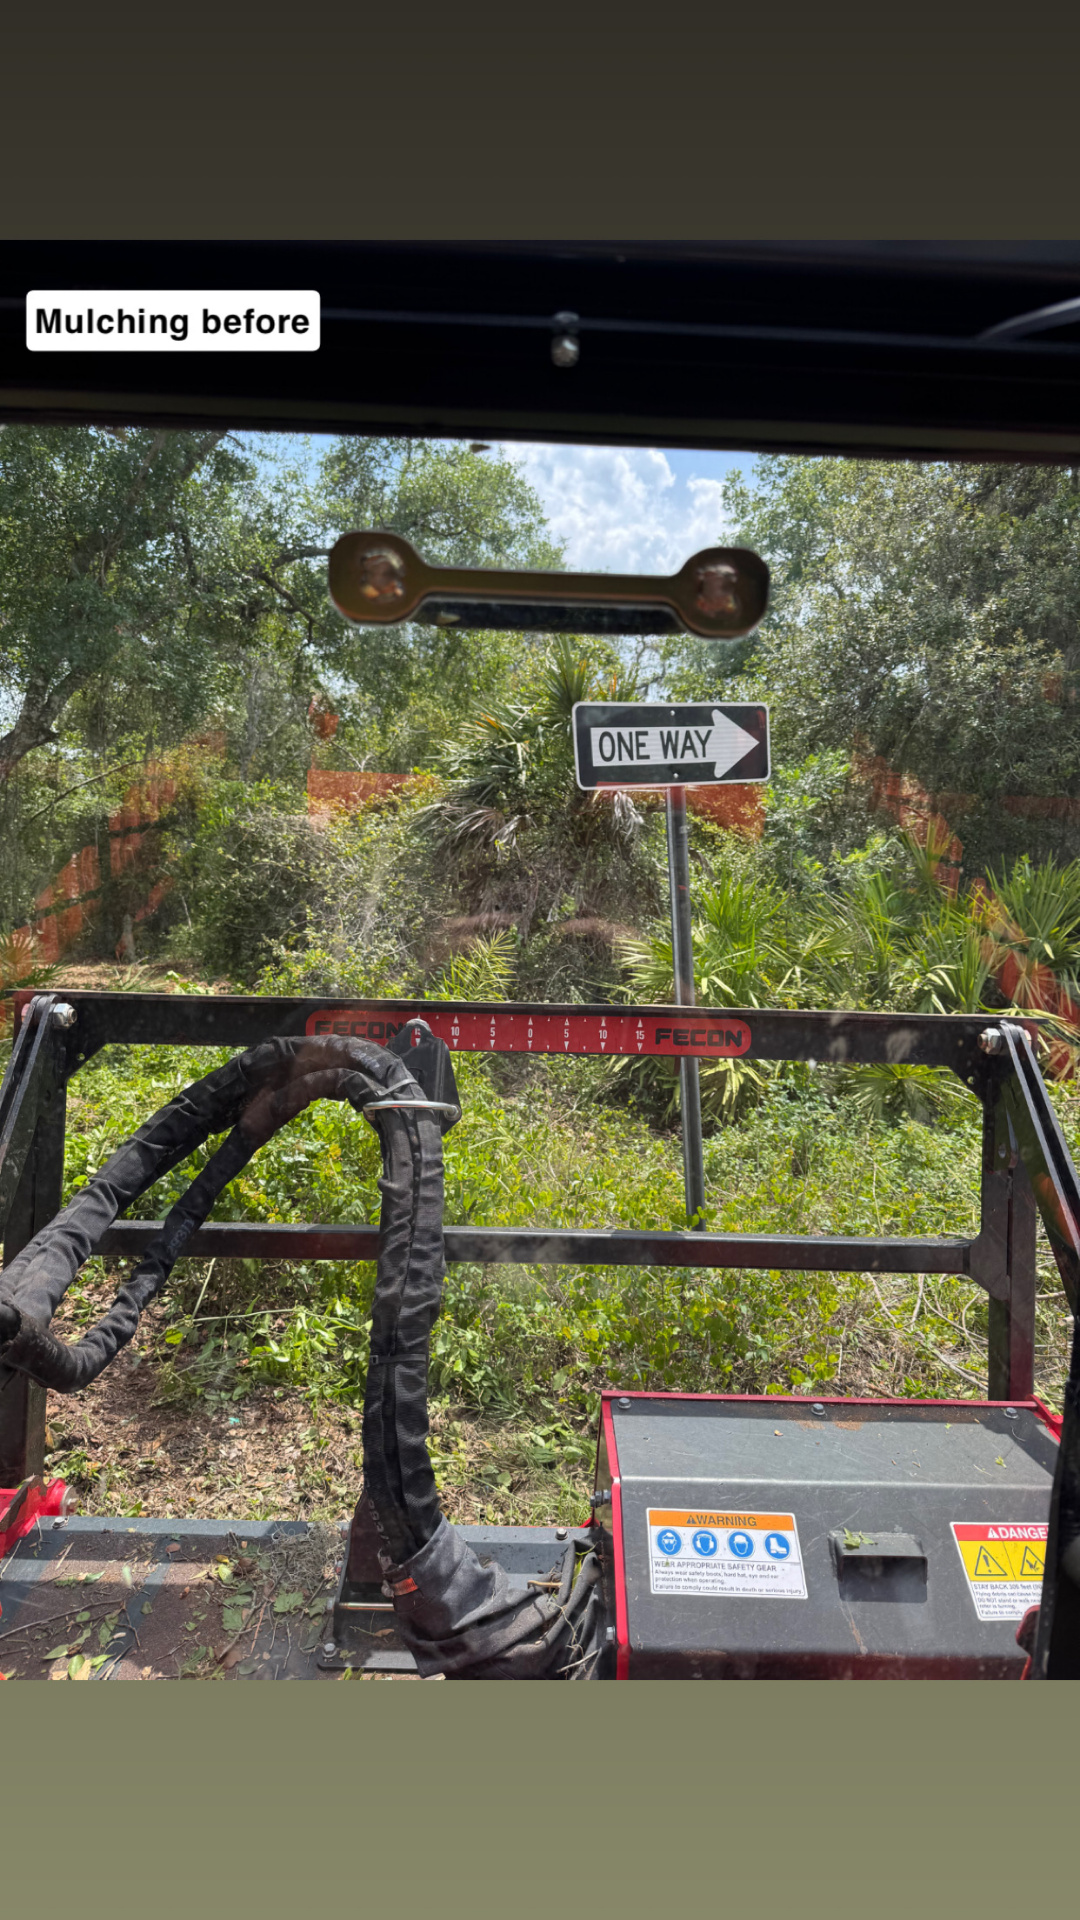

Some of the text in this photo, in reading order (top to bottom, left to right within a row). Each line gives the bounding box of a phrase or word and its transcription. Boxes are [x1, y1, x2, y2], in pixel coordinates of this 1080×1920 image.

[599, 730, 712, 762] ONE WAY
[315, 1020, 403, 1038] FECON
[451, 1027, 460, 1036] 10
[490, 1027, 495, 1036] 5
[528, 1028, 533, 1038] 0
[564, 1028, 569, 1038] 5
[599, 1030, 607, 1039] 10
[635, 1030, 645, 1040] 15
[655, 1028, 742, 1047] FECON
[697, 1515, 757, 1527] WARNING
[997, 1527, 1048, 1539] DANGE
[677, 1562, 726, 1570] APPROPRIATE
[727, 1563, 754, 1571] SAFETY
